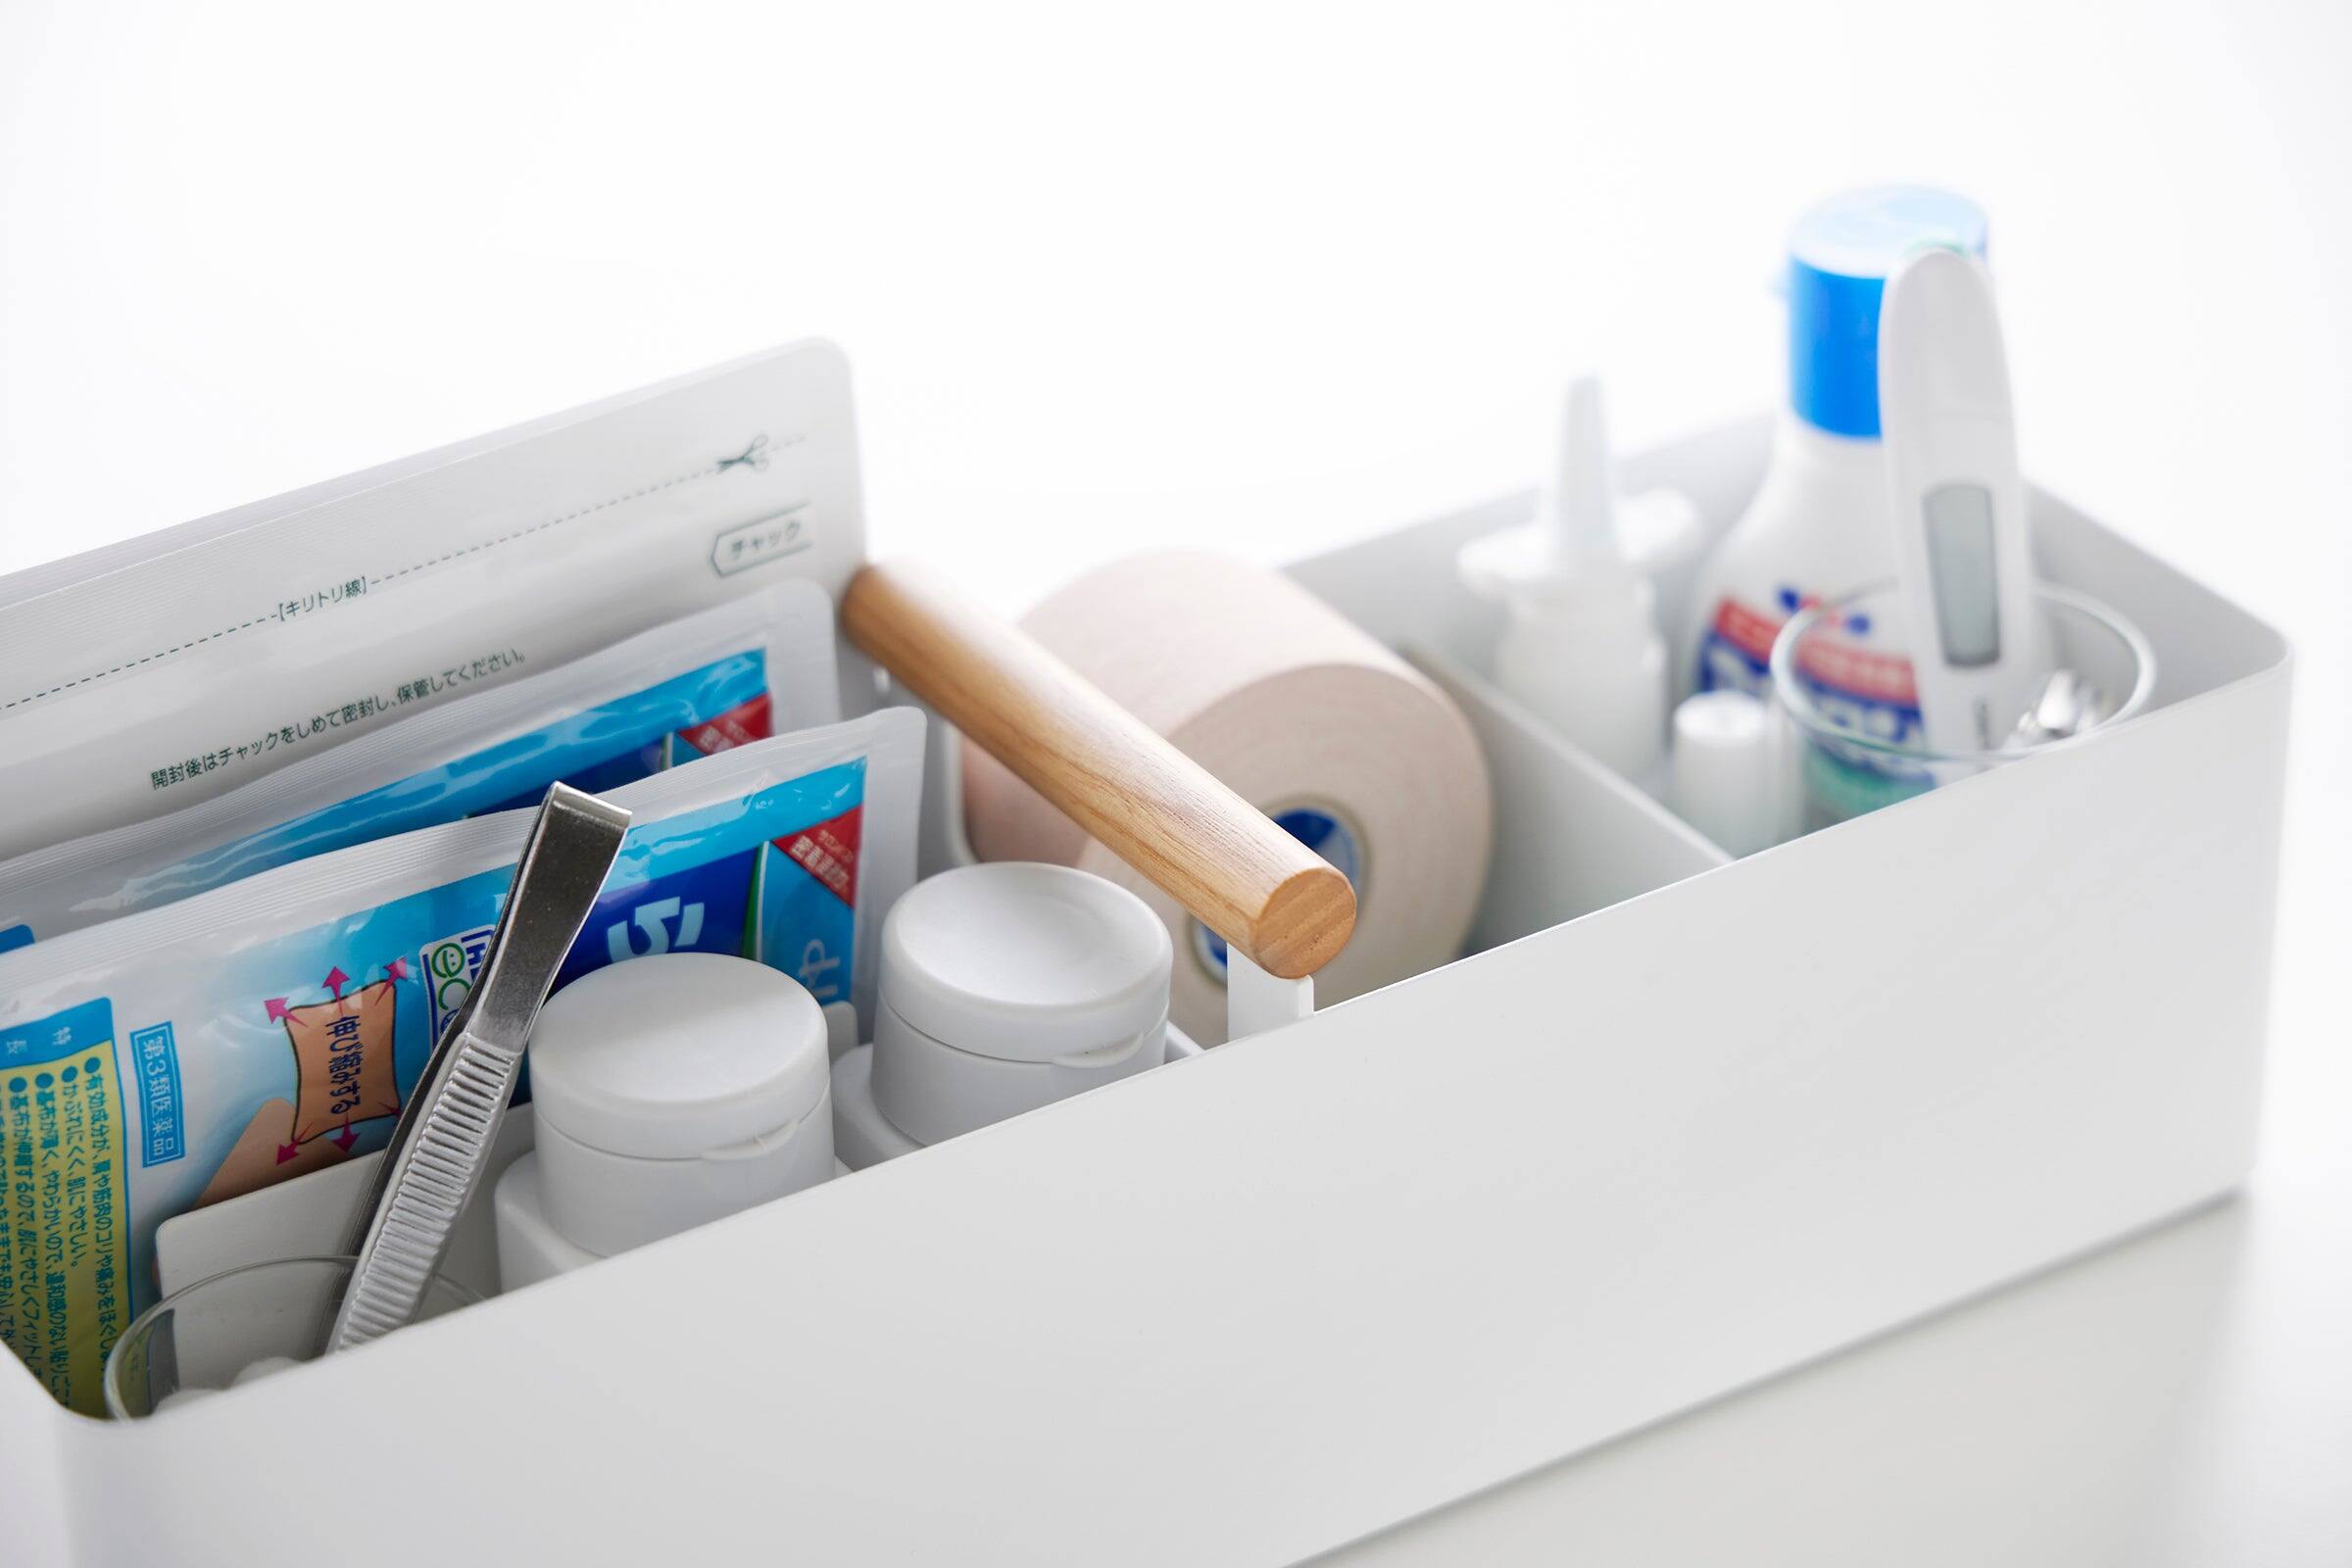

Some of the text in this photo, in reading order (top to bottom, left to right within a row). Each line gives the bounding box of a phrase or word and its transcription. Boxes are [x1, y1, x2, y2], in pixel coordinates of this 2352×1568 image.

[731, 520, 802, 562] チャック
[150, 649, 525, 791] 開封後はチャックをしめて密封し、保管してください。
[142, 1035, 175, 1156] 第3類医薬品
[324, 1014, 364, 1115] 伸び縮みする
